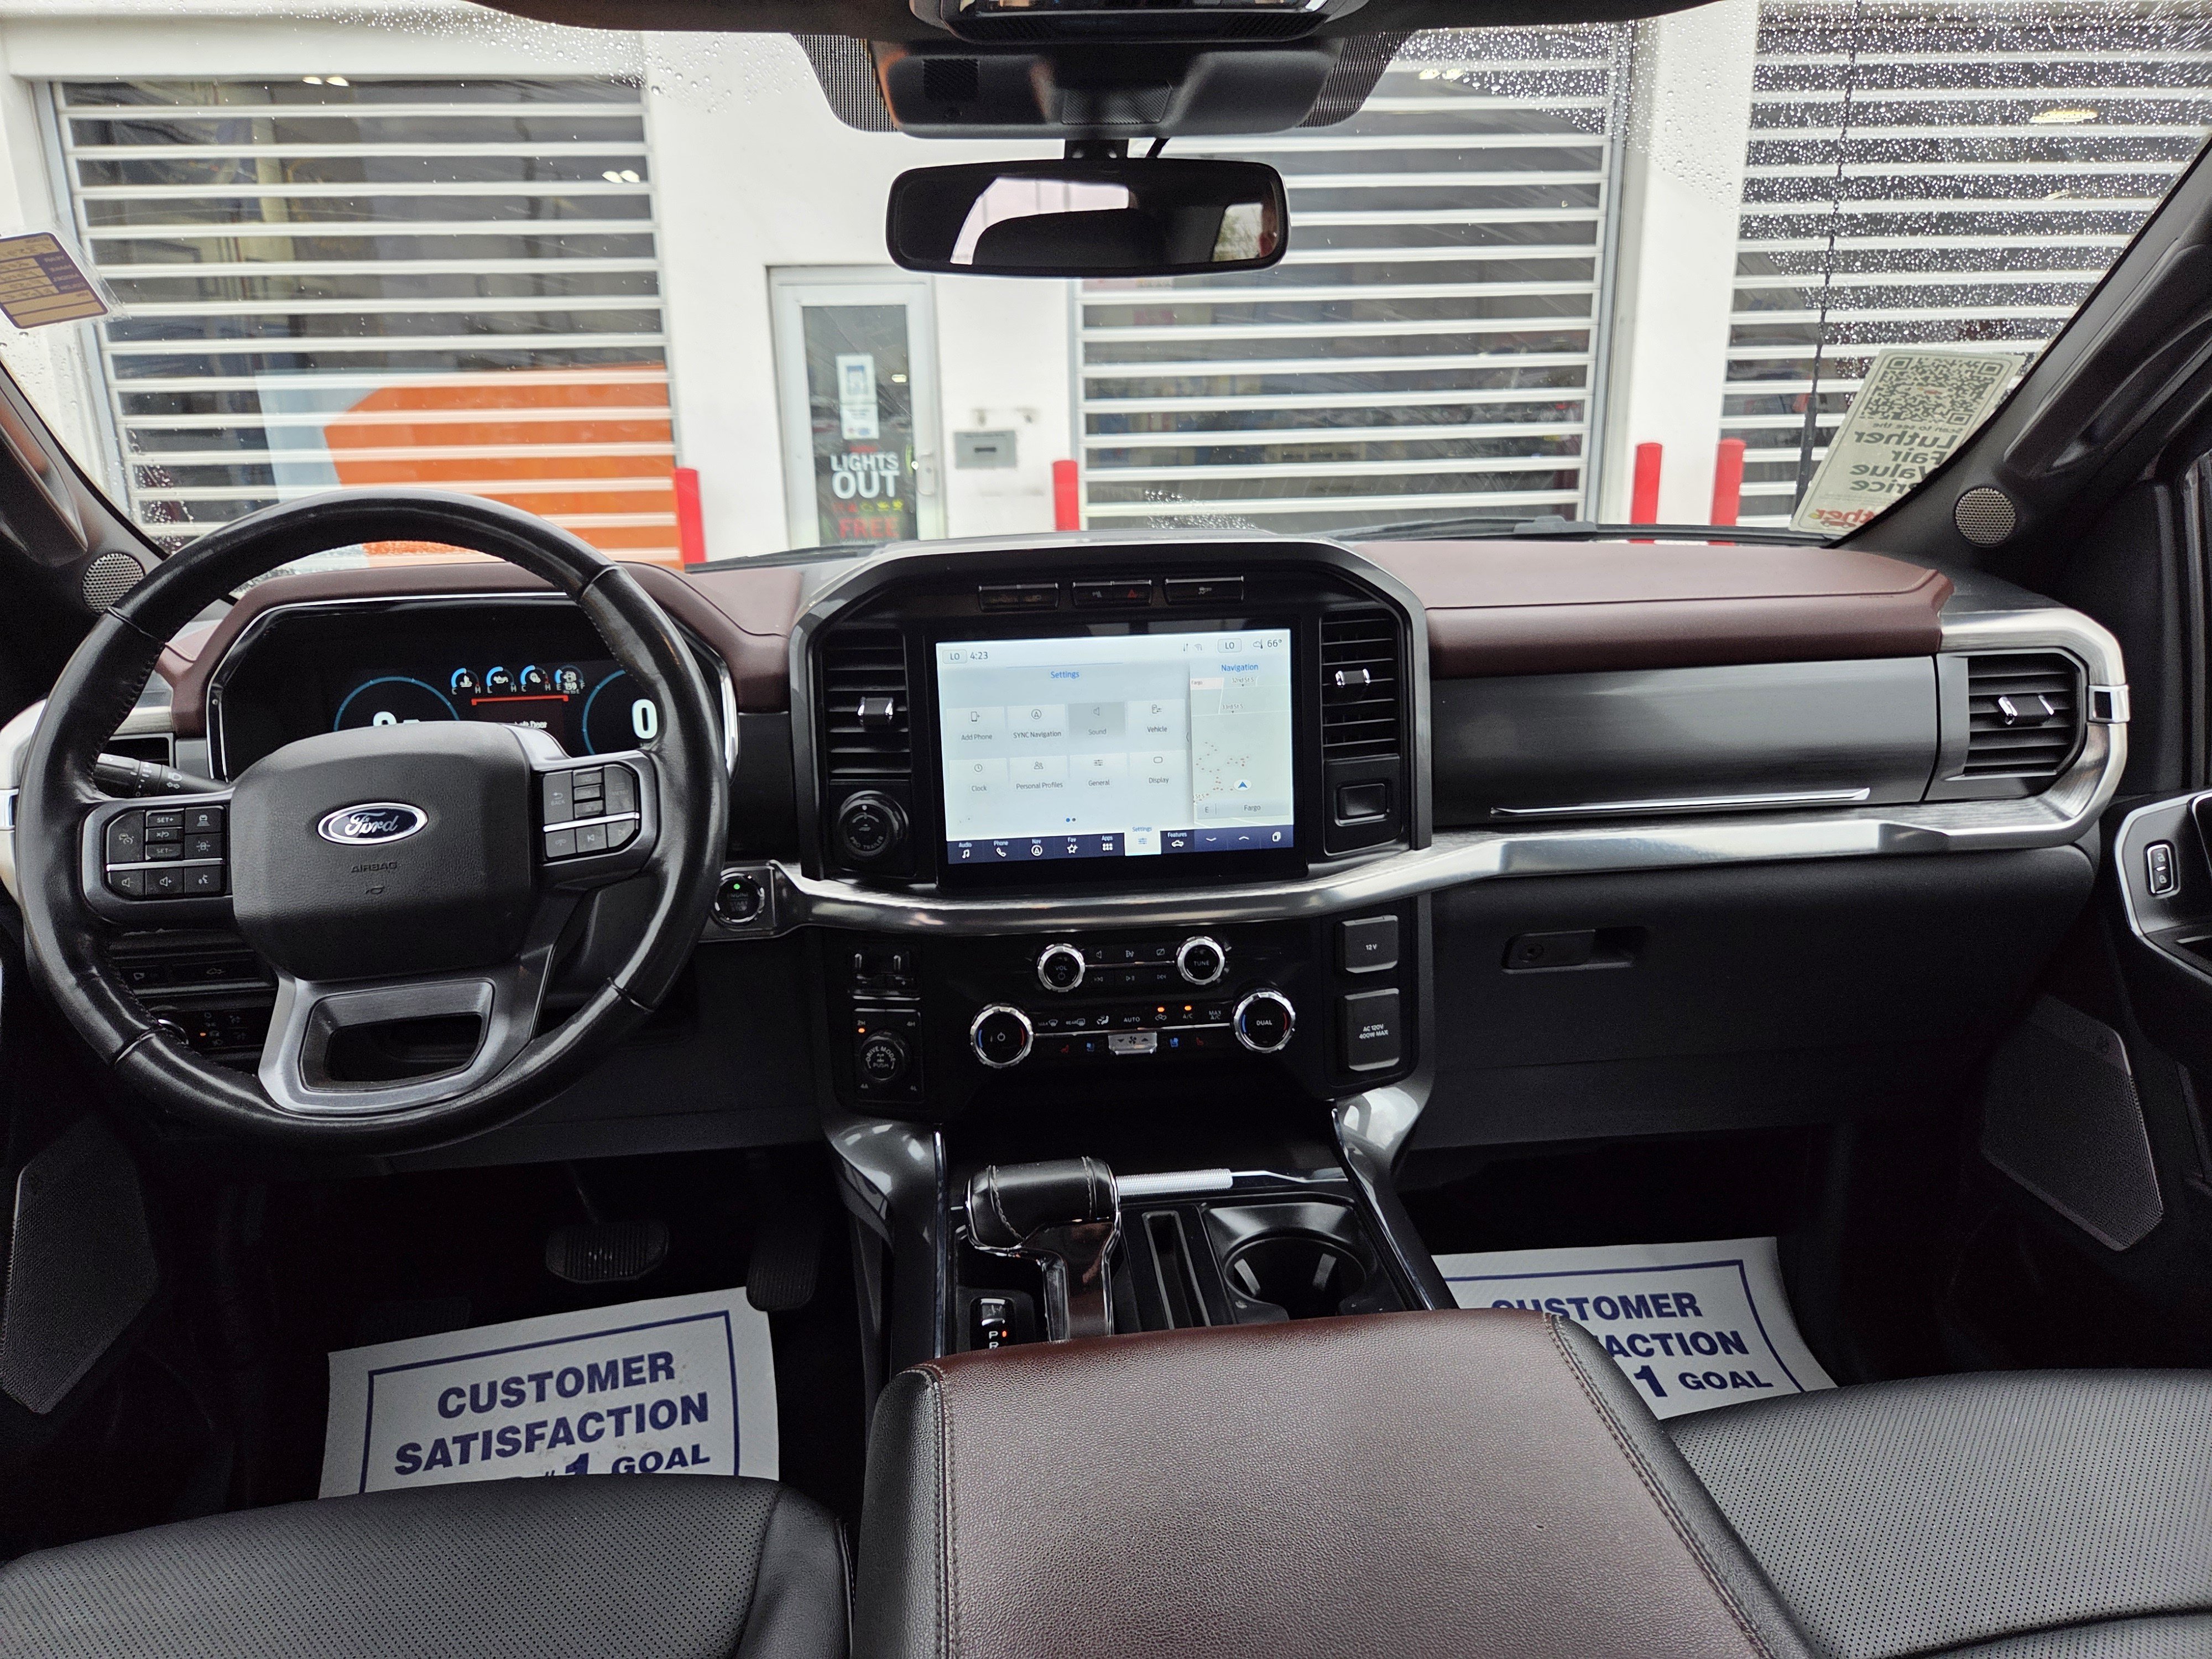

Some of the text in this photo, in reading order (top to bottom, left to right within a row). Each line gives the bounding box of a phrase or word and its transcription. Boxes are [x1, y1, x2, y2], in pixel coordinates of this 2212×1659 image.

[830, 452, 899, 471] LIGHTS
[832, 471, 900, 499] OUT
[839, 517, 900, 539] FREE
[1267, 639, 1282, 648] 66°
[970, 651, 988, 660] 4:23
[1050, 670, 1080, 679] Settings
[1221, 664, 1259, 672] Navigation
[564, 682, 577, 690] 159
[530, 720, 547, 729] Door
[632, 698, 658, 739] 0
[1030, 731, 1062, 739] Navigation
[1147, 725, 1167, 733] Vehicle
[345, 812, 399, 836] Ford
[351, 862, 398, 873] AIRBAG
[865, 1046, 880, 1062] DRIVE
[989, 1331, 999, 1340] P
[1593, 1330, 1750, 1358] ACTION
[437, 1350, 676, 1419] CUSTOMER
[1678, 1371, 1774, 1390] GOAL
[394, 1391, 709, 1475] SATISFACTION
[611, 1443, 711, 1475] GOAL
